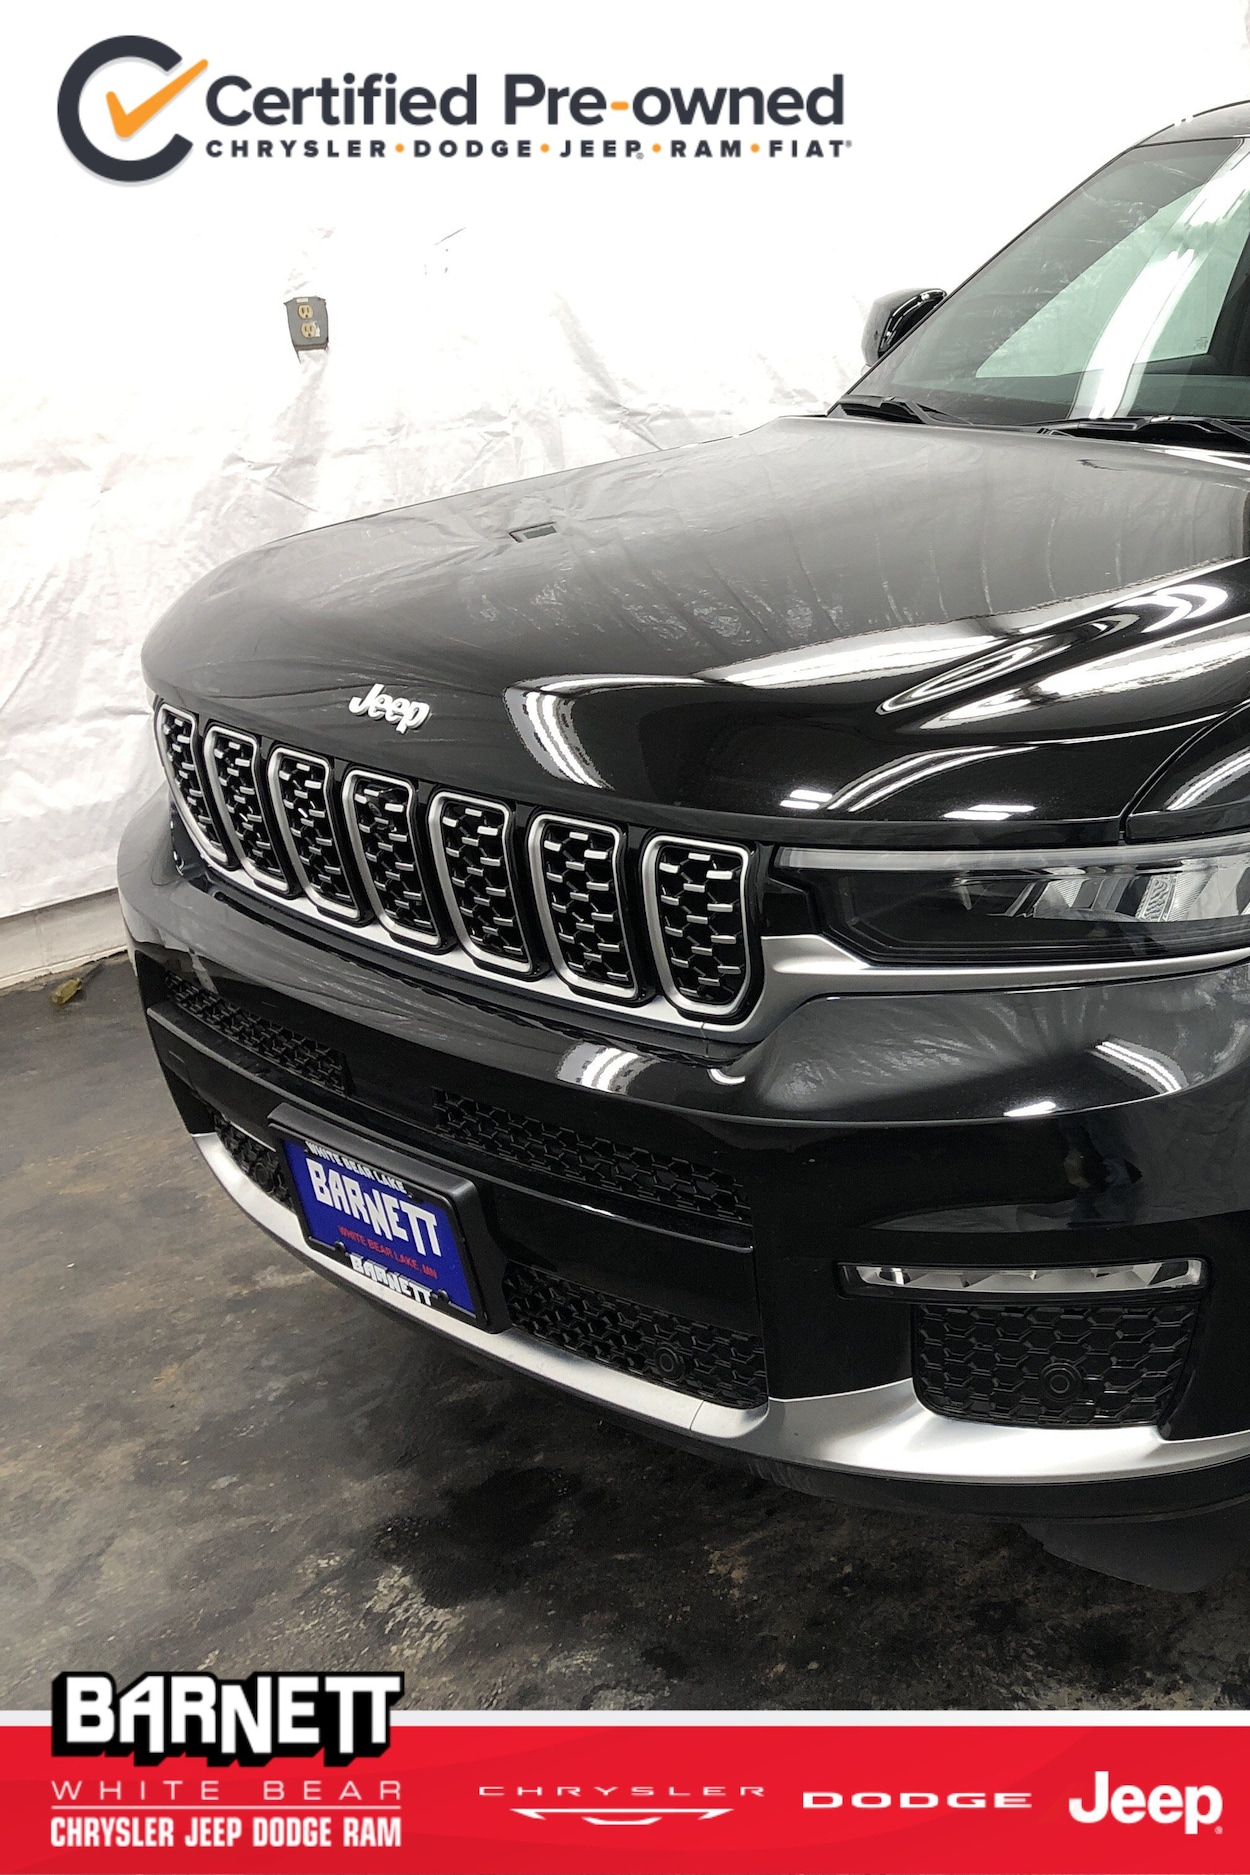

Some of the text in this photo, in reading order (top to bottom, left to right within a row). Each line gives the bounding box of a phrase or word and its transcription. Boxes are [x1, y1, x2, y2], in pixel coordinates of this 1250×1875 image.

[348, 683, 432, 734] Jeep
[305, 1141, 408, 1194] WHITE BEAR LAKE
[305, 1158, 442, 1257] BARNETT
[339, 1226, 367, 1247] WHITE
[367, 1237, 394, 1258] BEAR
[349, 1252, 434, 1307] BARNETT
